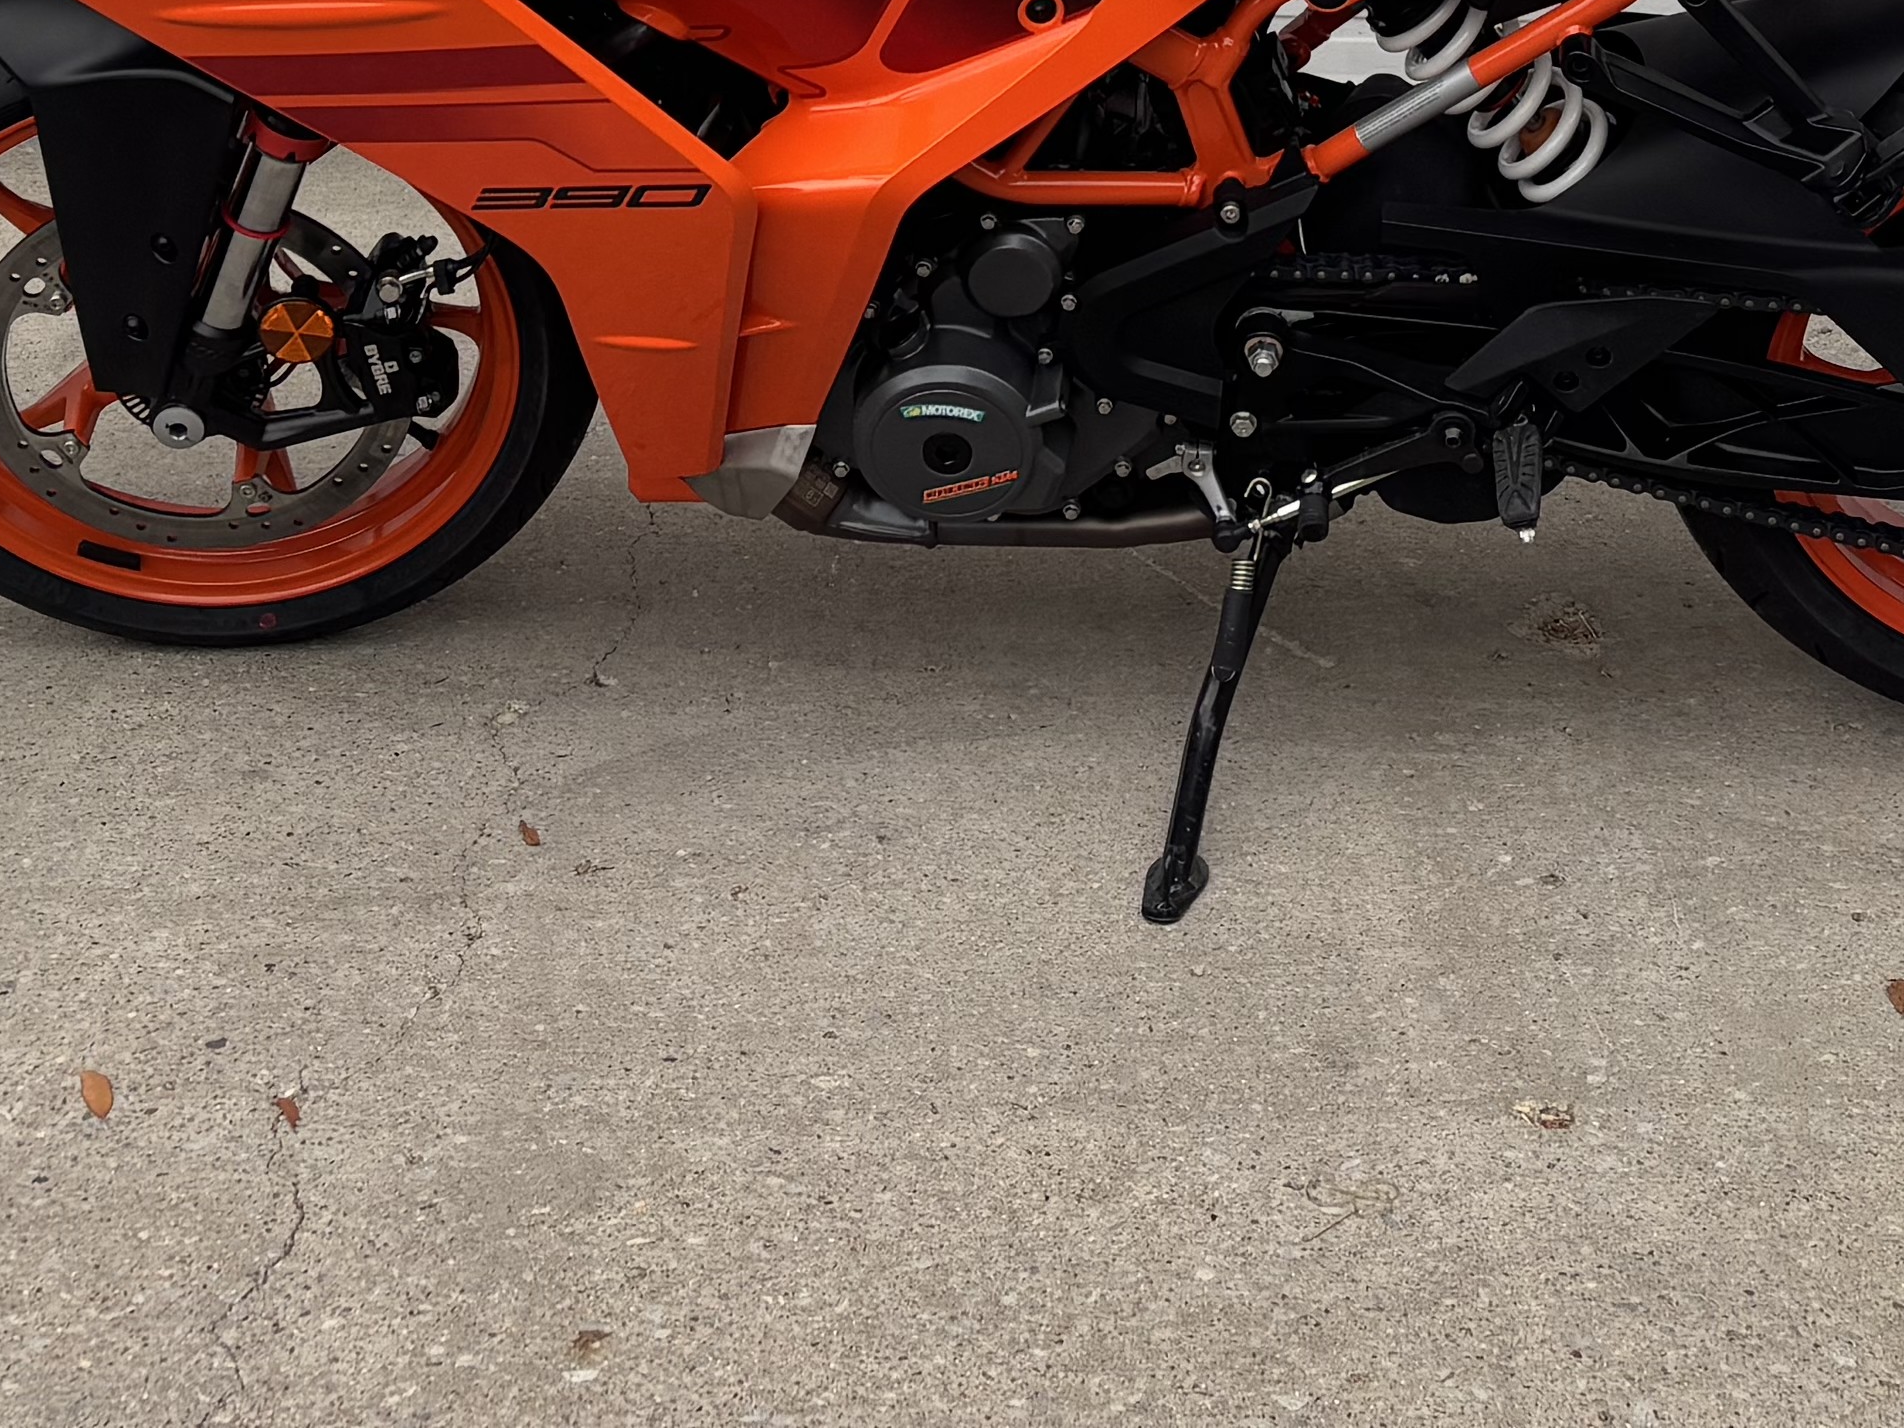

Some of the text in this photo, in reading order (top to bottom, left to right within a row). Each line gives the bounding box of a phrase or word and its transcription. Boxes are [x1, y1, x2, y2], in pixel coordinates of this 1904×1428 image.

[471, 184, 712, 211] 390
[364, 344, 392, 395] BYBRE
[921, 405, 983, 422] MOTOREX
